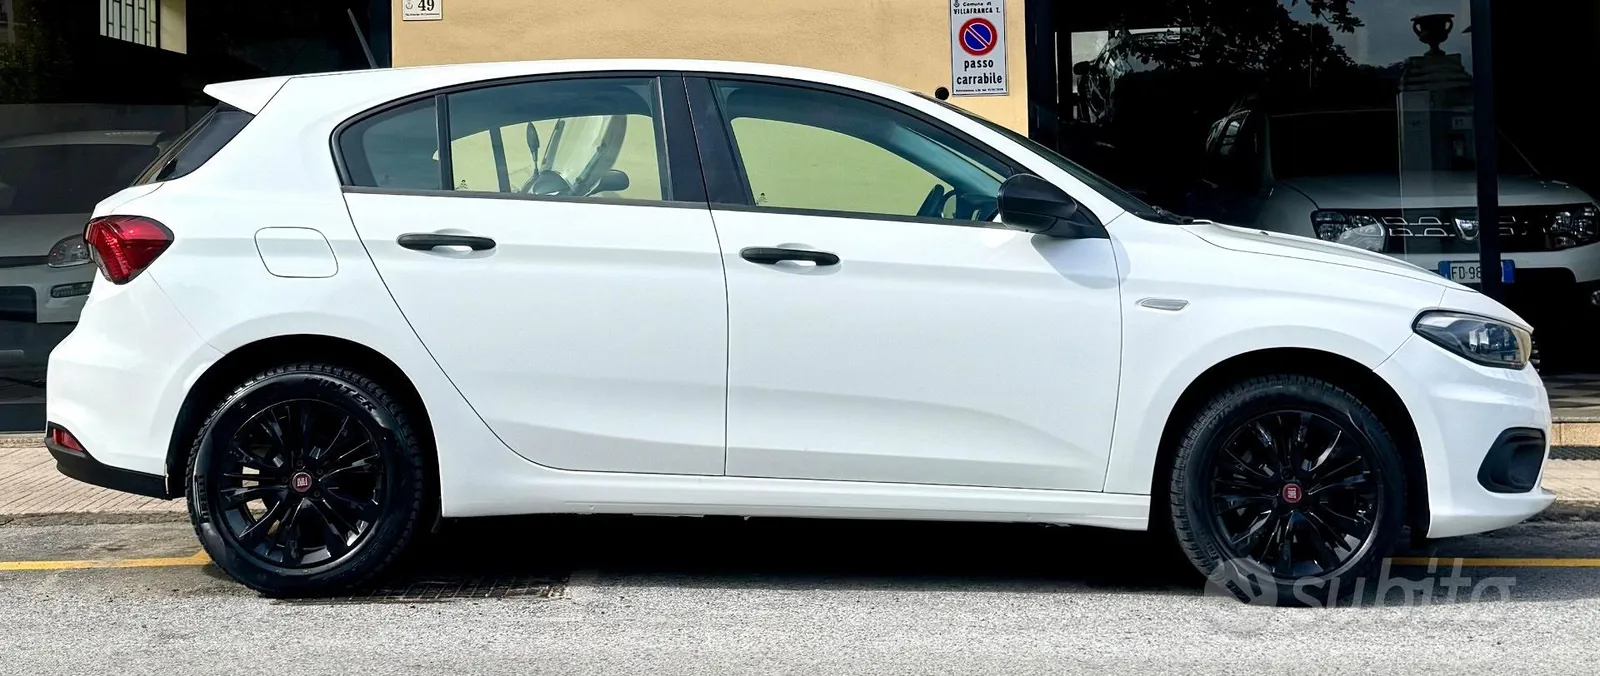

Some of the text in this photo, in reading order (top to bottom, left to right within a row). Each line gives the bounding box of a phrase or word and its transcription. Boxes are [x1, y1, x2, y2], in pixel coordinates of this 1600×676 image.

[418, 0, 434, 11] 49
[953, 7, 993, 15] VILLAFRANCA
[964, 59, 994, 72] passo
[956, 72, 1003, 85] carrabile
